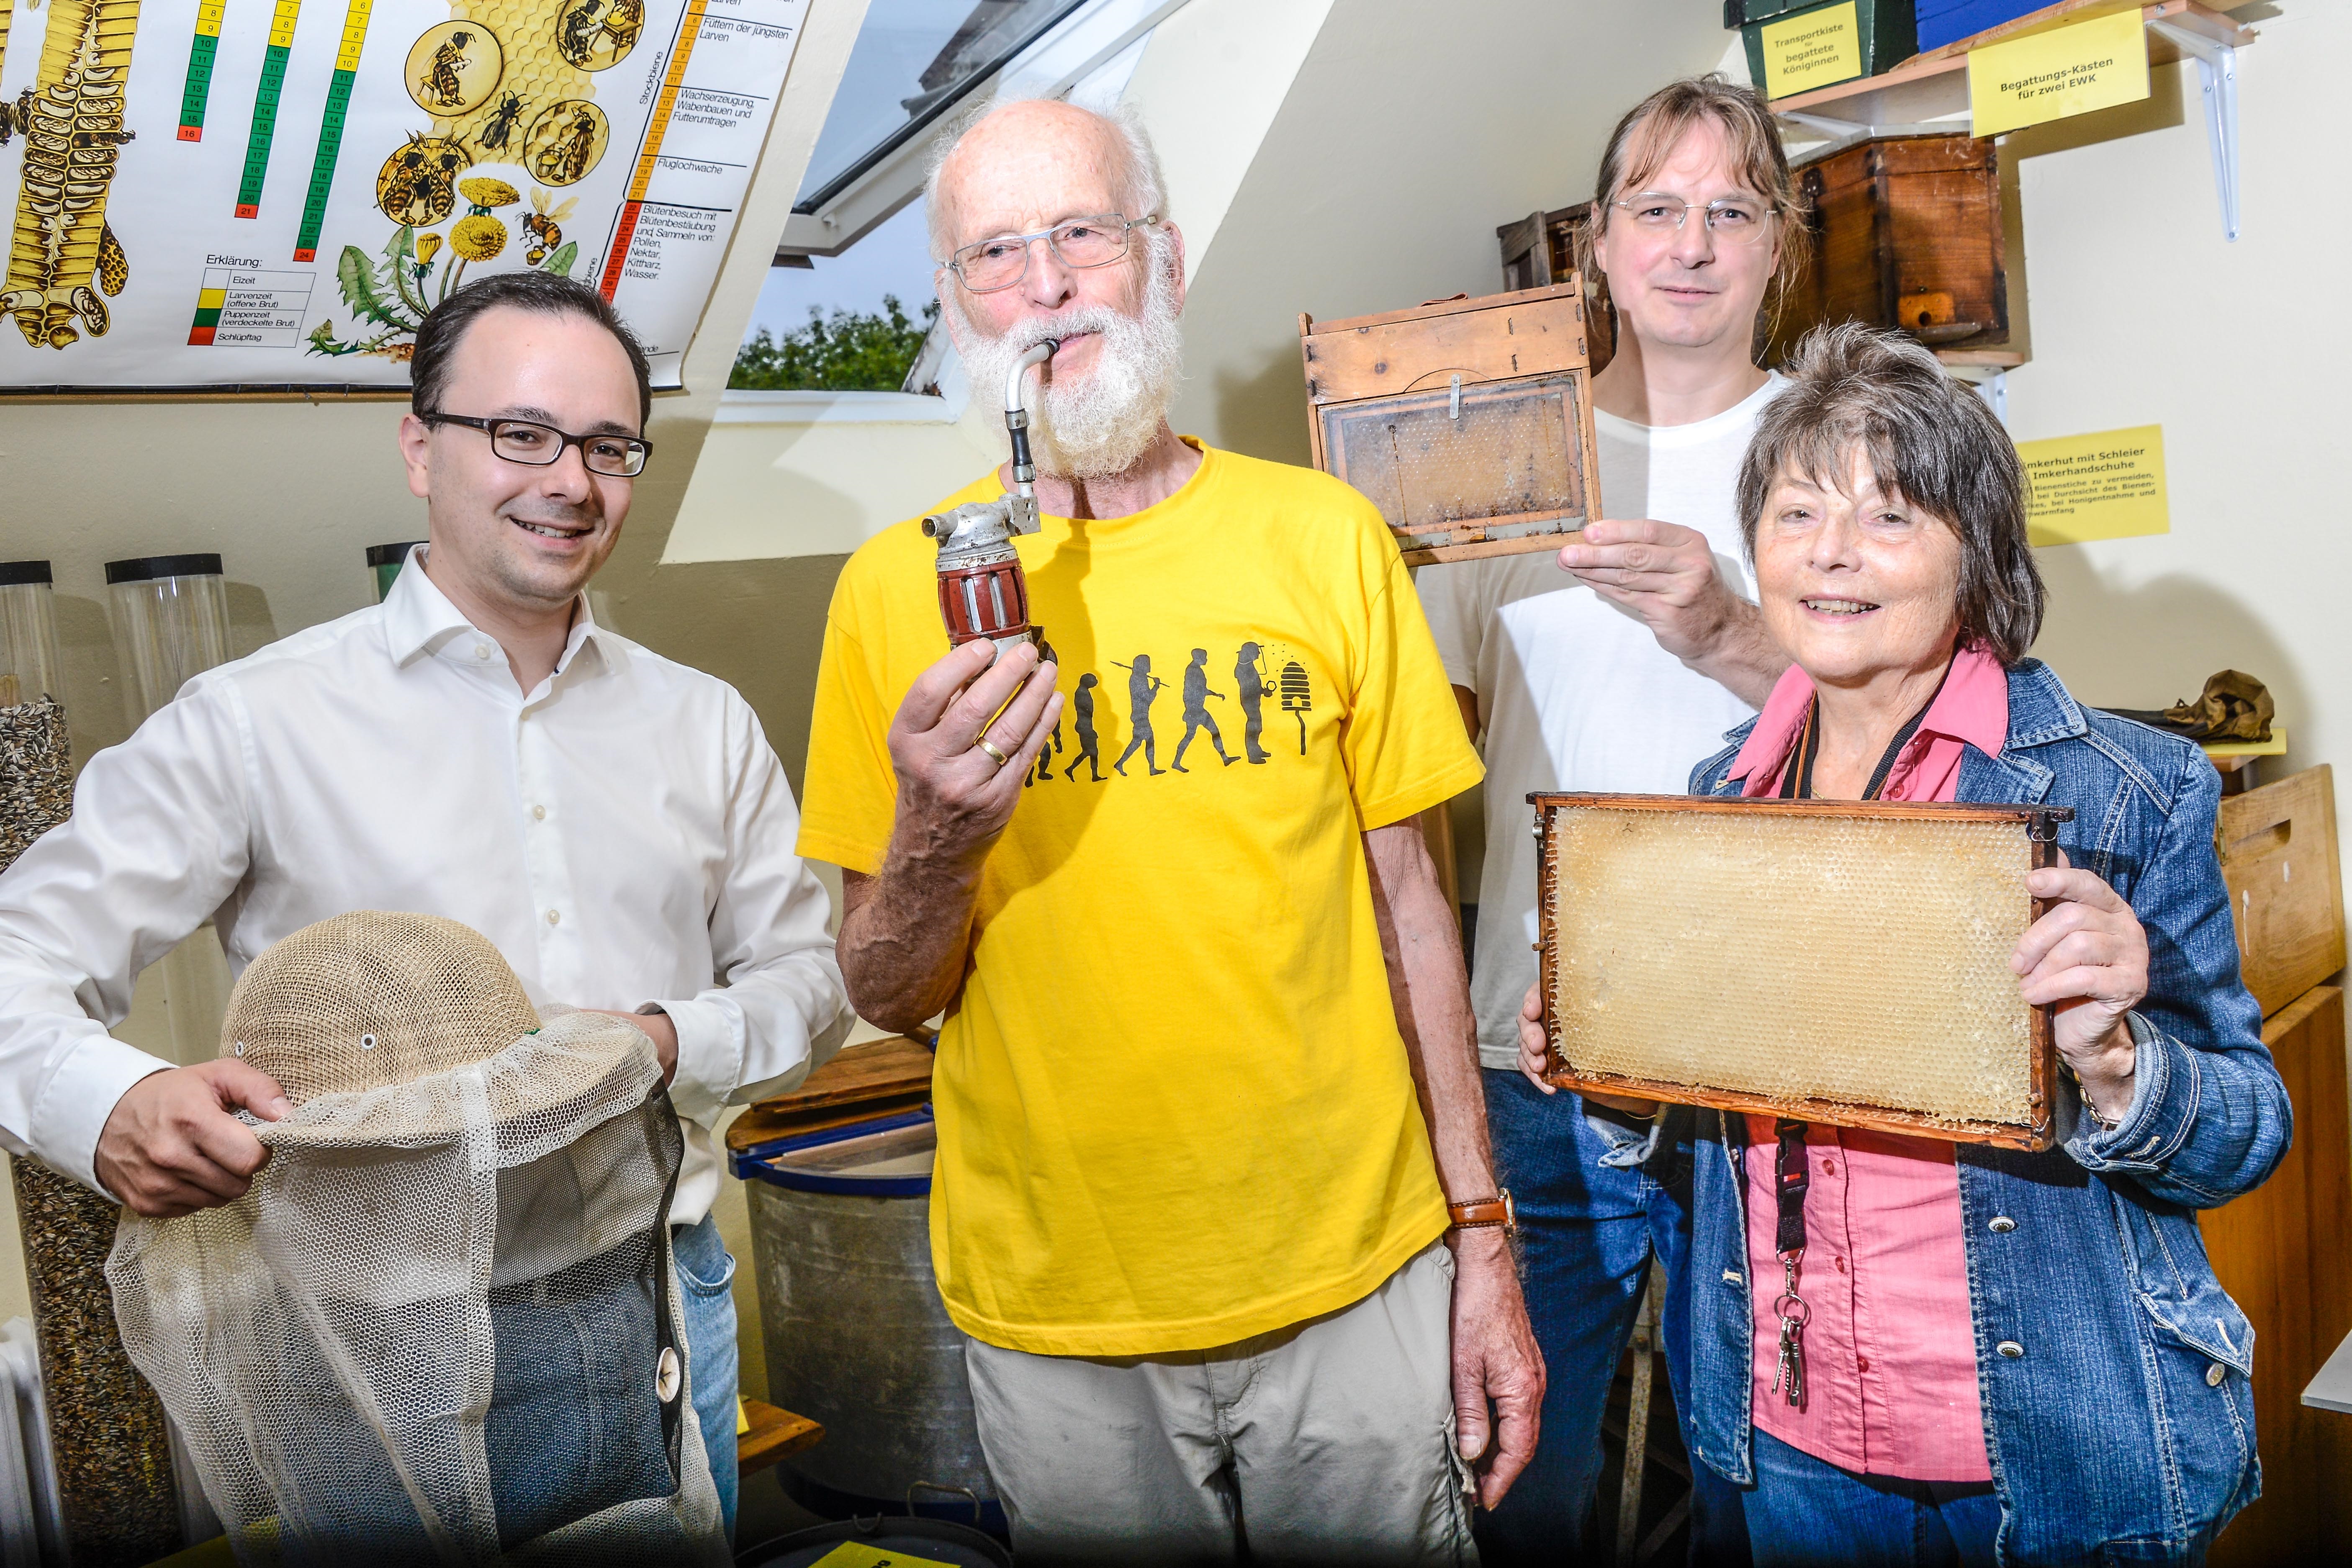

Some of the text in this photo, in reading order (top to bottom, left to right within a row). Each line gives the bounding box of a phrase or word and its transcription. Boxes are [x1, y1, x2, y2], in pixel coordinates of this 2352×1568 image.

[699, 29, 729, 42] Larven
[703, 18, 789, 40] Füttern der jüngsten
[1774, 24, 1843, 48] Transportkiste
[1786, 44, 1834, 63] begattete
[1783, 54, 1839, 75] Königinnen
[640, 51, 663, 105] Stockbiene
[2001, 57, 2113, 92] Begattungs-Kästen
[2018, 73, 2097, 100] für zwei EWK
[681, 89, 754, 108] Wachserzeugung,
[677, 100, 751, 118] Wabenbauen und
[673, 112, 736, 128] Futterumtragen
[658, 158, 722, 174] Fluglochwache
[643, 205, 702, 219] Blütenbesuch
[640, 216, 715, 232] Blütenbestäubung
[633, 237, 661, 248] Pollen,
[656, 229, 695, 240] Sammeln
[206, 254, 263, 268] Erklärung:
[630, 247, 661, 259] Nektar,
[627, 259, 661, 270] Kittharz,
[625, 269, 659, 280] Wasser.
[218, 334, 262, 342] Schlüpftag
[2027, 448, 2145, 469] mkerhut mit Schleier
[2033, 461, 2134, 480] Imkerhandschuhe
[2035, 481, 2087, 491] Bienenstiche
[2106, 473, 2154, 483] vermeiden,
[2054, 488, 2098, 498] Durchsicht
[2069, 492, 2134, 504] Honigentnahme
